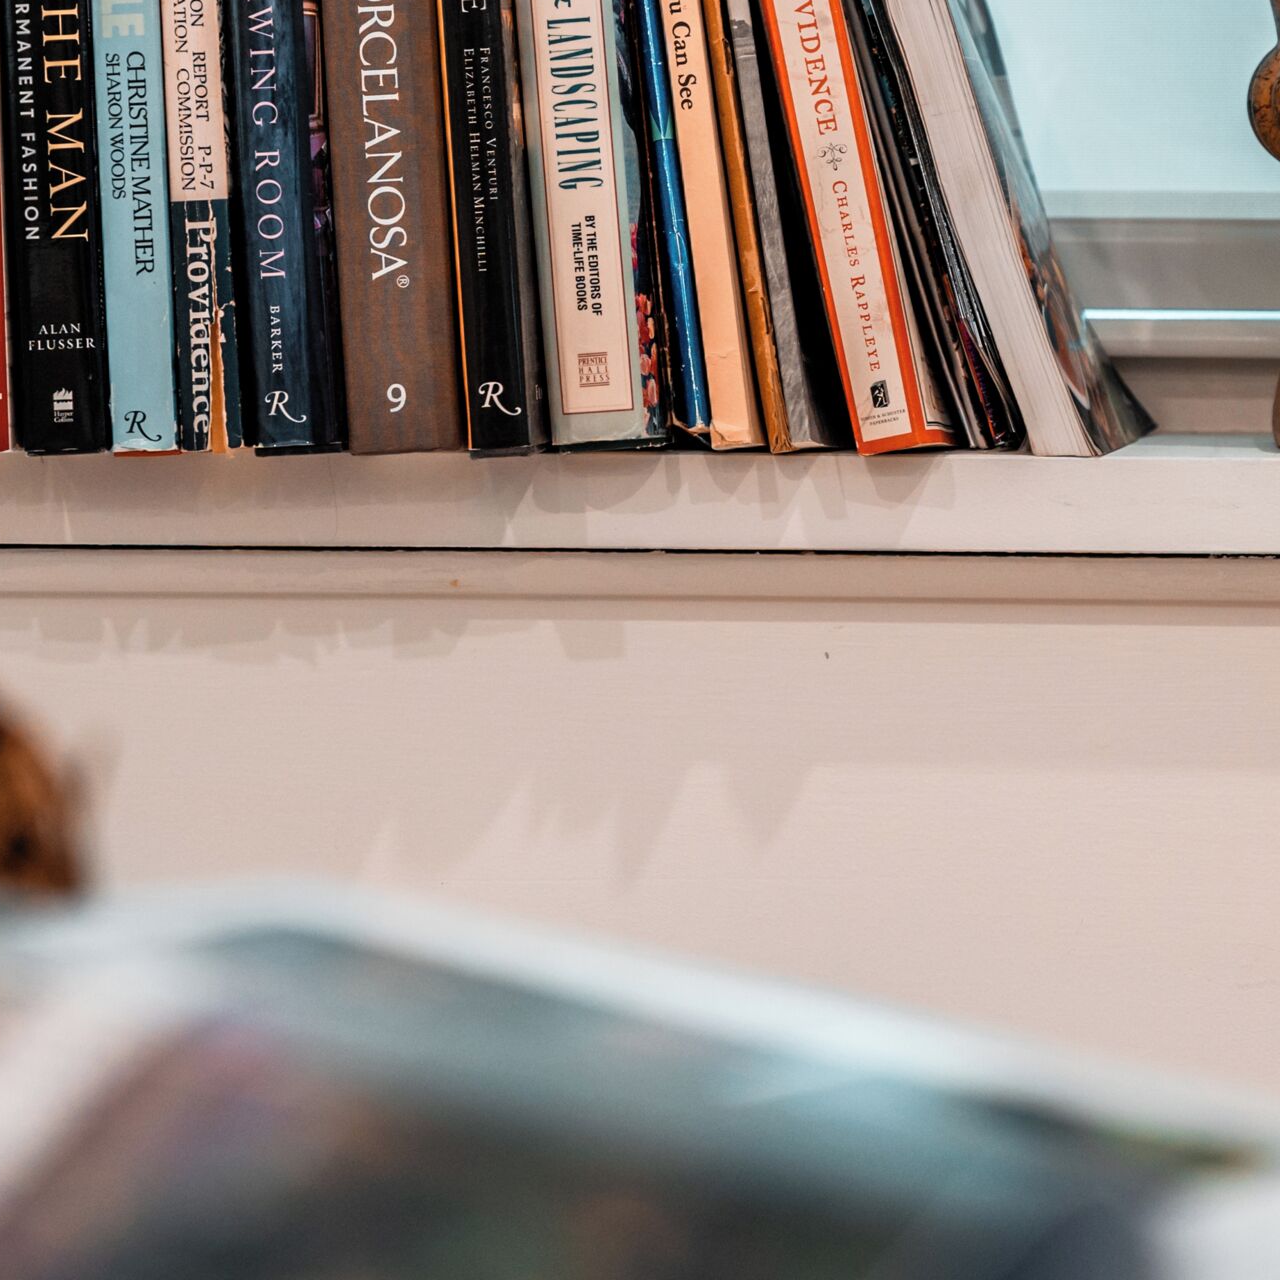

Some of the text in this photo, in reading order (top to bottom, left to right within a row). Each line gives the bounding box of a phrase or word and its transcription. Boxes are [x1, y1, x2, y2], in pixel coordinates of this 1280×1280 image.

[191, 51, 210, 122] REPORT
[671, 20, 689, 68] Can
[105, 53, 127, 200] SHARON WOODS
[175, 68, 197, 191] COMMISSION
[479, 46, 500, 201] FRANCESCO VENTURI
[546, 15, 605, 191] LANDSCAPING
[677, 74, 697, 111] See
[20, 132, 40, 240] FASHION
[46, 107, 89, 242] MAN
[125, 50, 156, 276] CHRISTINE MATHER
[197, 145, 215, 191] P-P-7
[463, 47, 488, 273] ELIZABETH HELMAN MINCHILLI
[253, 148, 287, 280] ROOM
[575, 275, 589, 312] BOOKS
[584, 215, 604, 317] BY THE EDITORS OF
[832, 179, 881, 373] CHARLES RAPPLEYE
[28, 336, 96, 351] FLUSSER
[38, 322, 81, 335] ALAN
[185, 217, 218, 434] Providence
[269, 305, 283, 374] BARKER
[123, 410, 162, 442] R
[264, 390, 307, 423] R
[386, 383, 407, 413] 9
[478, 381, 522, 416] R
